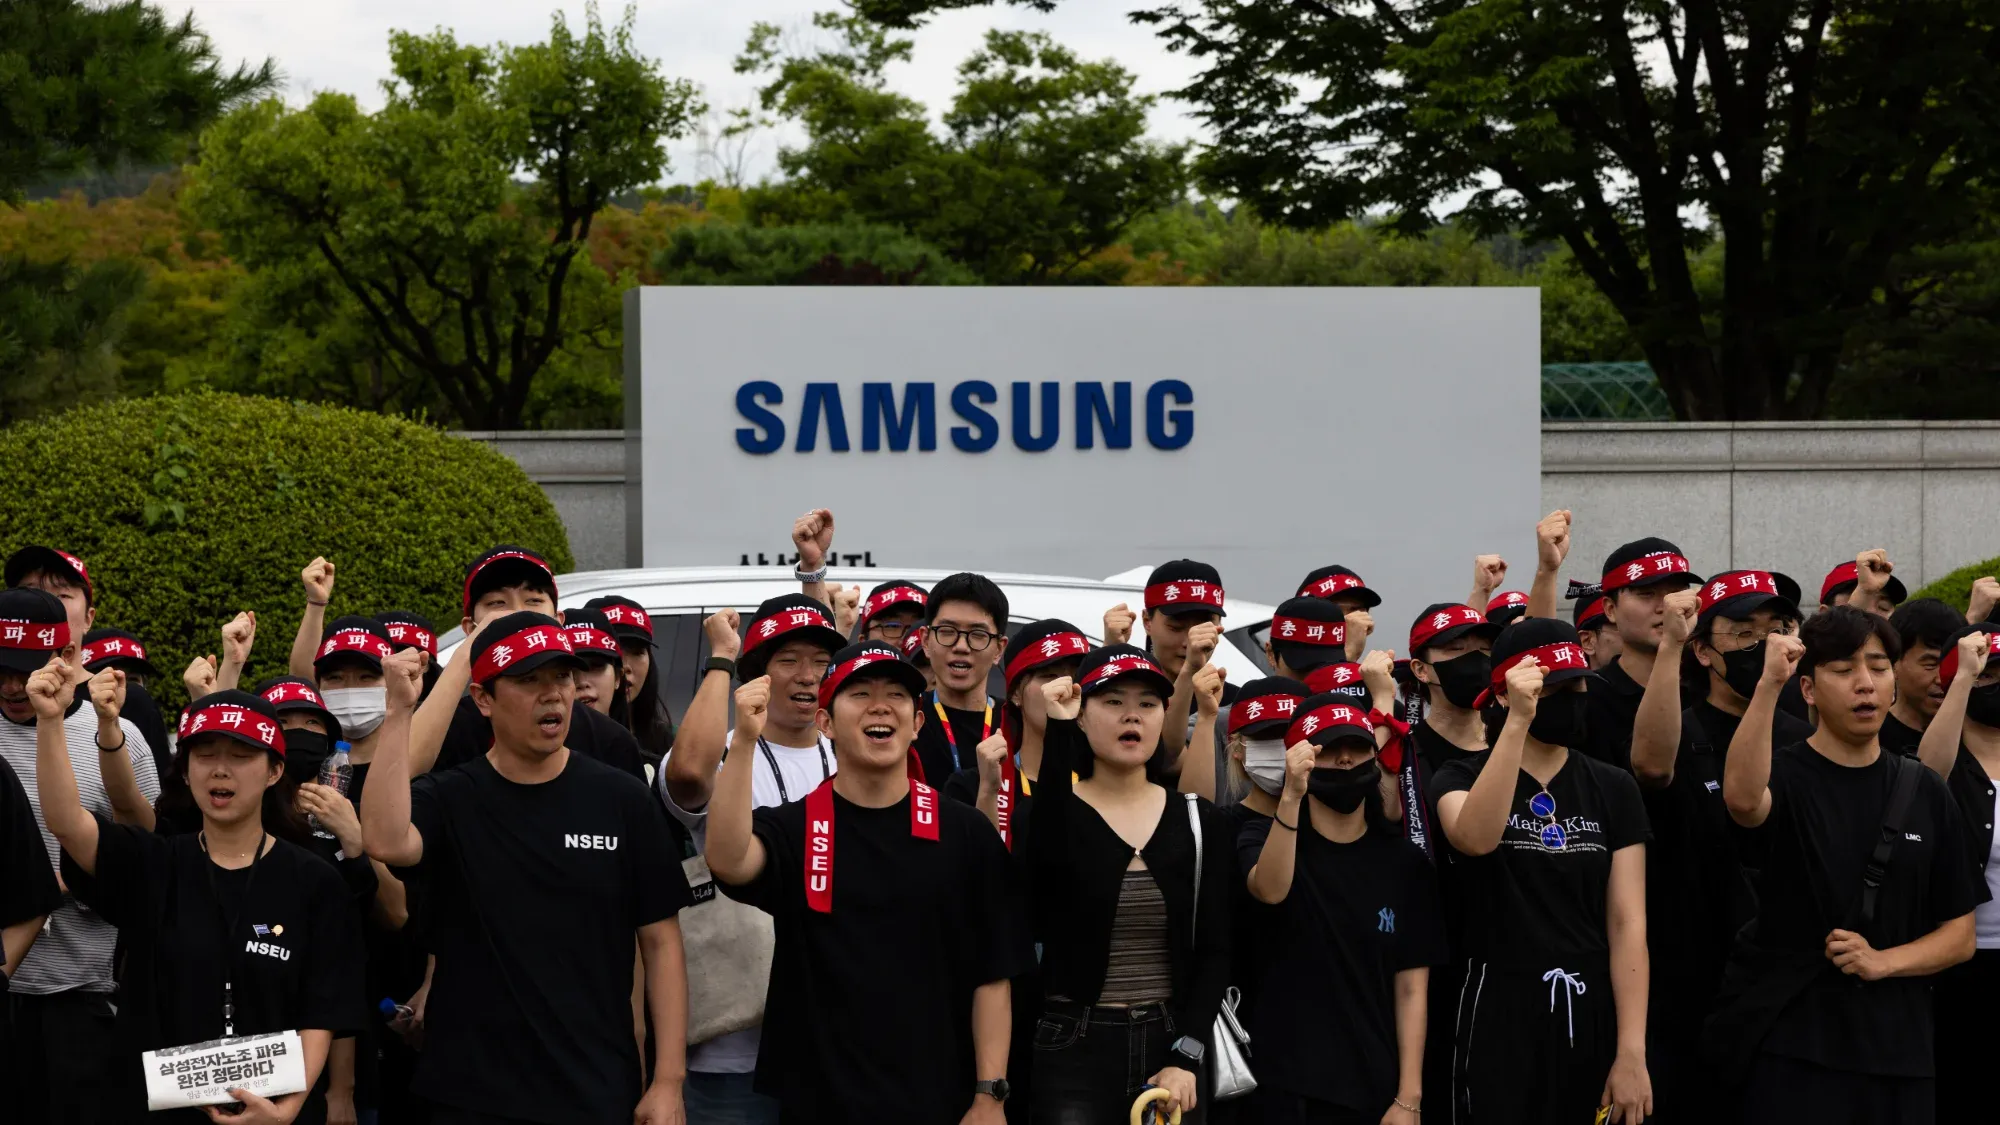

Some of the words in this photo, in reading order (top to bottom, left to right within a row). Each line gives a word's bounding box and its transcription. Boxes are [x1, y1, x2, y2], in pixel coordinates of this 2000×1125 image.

[735, 380, 1194, 455] SAMSUNG
[1562, 816, 1602, 834] Kim
[564, 833, 619, 851] NSEU
[810, 820, 829, 892] NSEU
[245, 940, 291, 961] NSEU
[159, 1046, 253, 1077] 삼성전자노조
[254, 1041, 288, 1060] 파업
[177, 1070, 210, 1090] 완전
[212, 1059, 275, 1085] 정당하다
